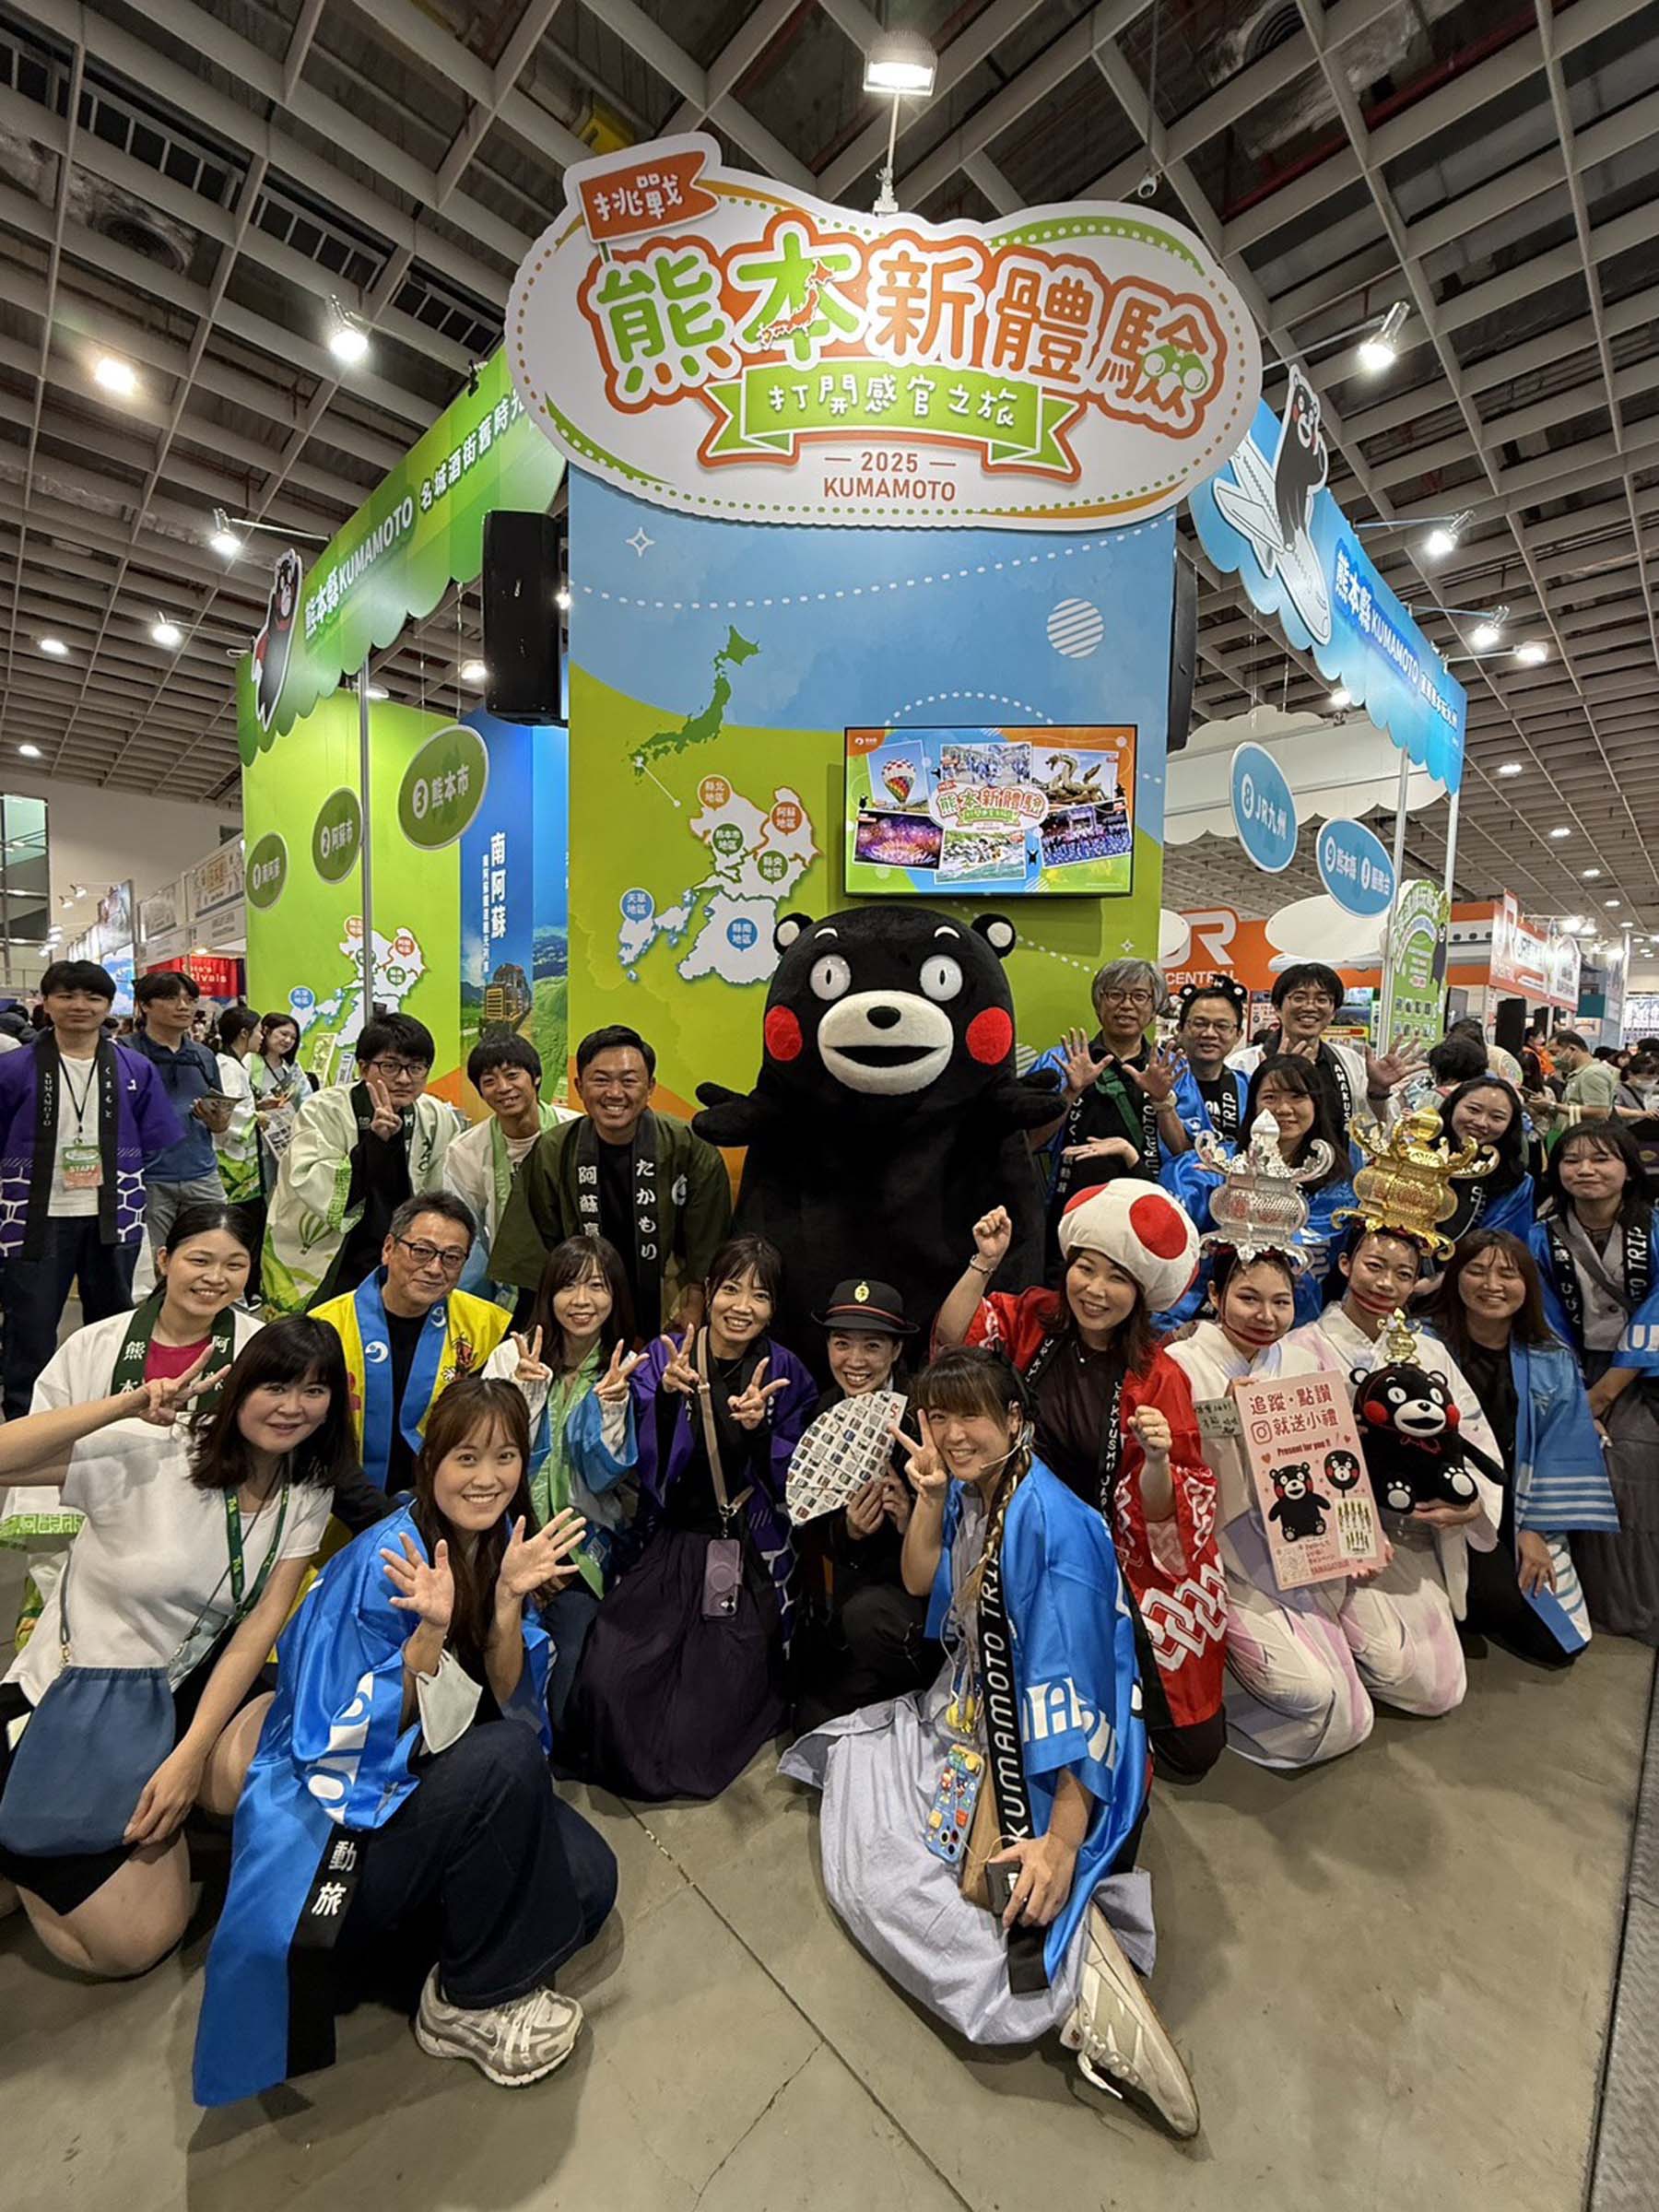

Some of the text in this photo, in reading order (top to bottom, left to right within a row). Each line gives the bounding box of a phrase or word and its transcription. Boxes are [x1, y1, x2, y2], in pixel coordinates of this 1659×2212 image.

[594, 173, 683, 221] 挑戰
[597, 230, 1209, 421] 熊本新體驗
[768, 373, 1020, 429] 打開感官之旅
[822, 477, 957, 502] KUMAMOTO
[861, 452, 918, 475] 2025
[431, 764, 470, 809] 熊本市
[1254, 794, 1288, 841] JR九州
[490, 831, 506, 938] 南阿蘇
[1222, 1091, 1237, 1129] TRIP
[636, 1159, 657, 1260] たかもり
[1106, 1403, 1121, 1471] KYUSHU
[1273, 1408, 1338, 1436] 就送小禮
[983, 1631, 1030, 1843] KUMAMOTO
[312, 1840, 357, 1917] 動旅
